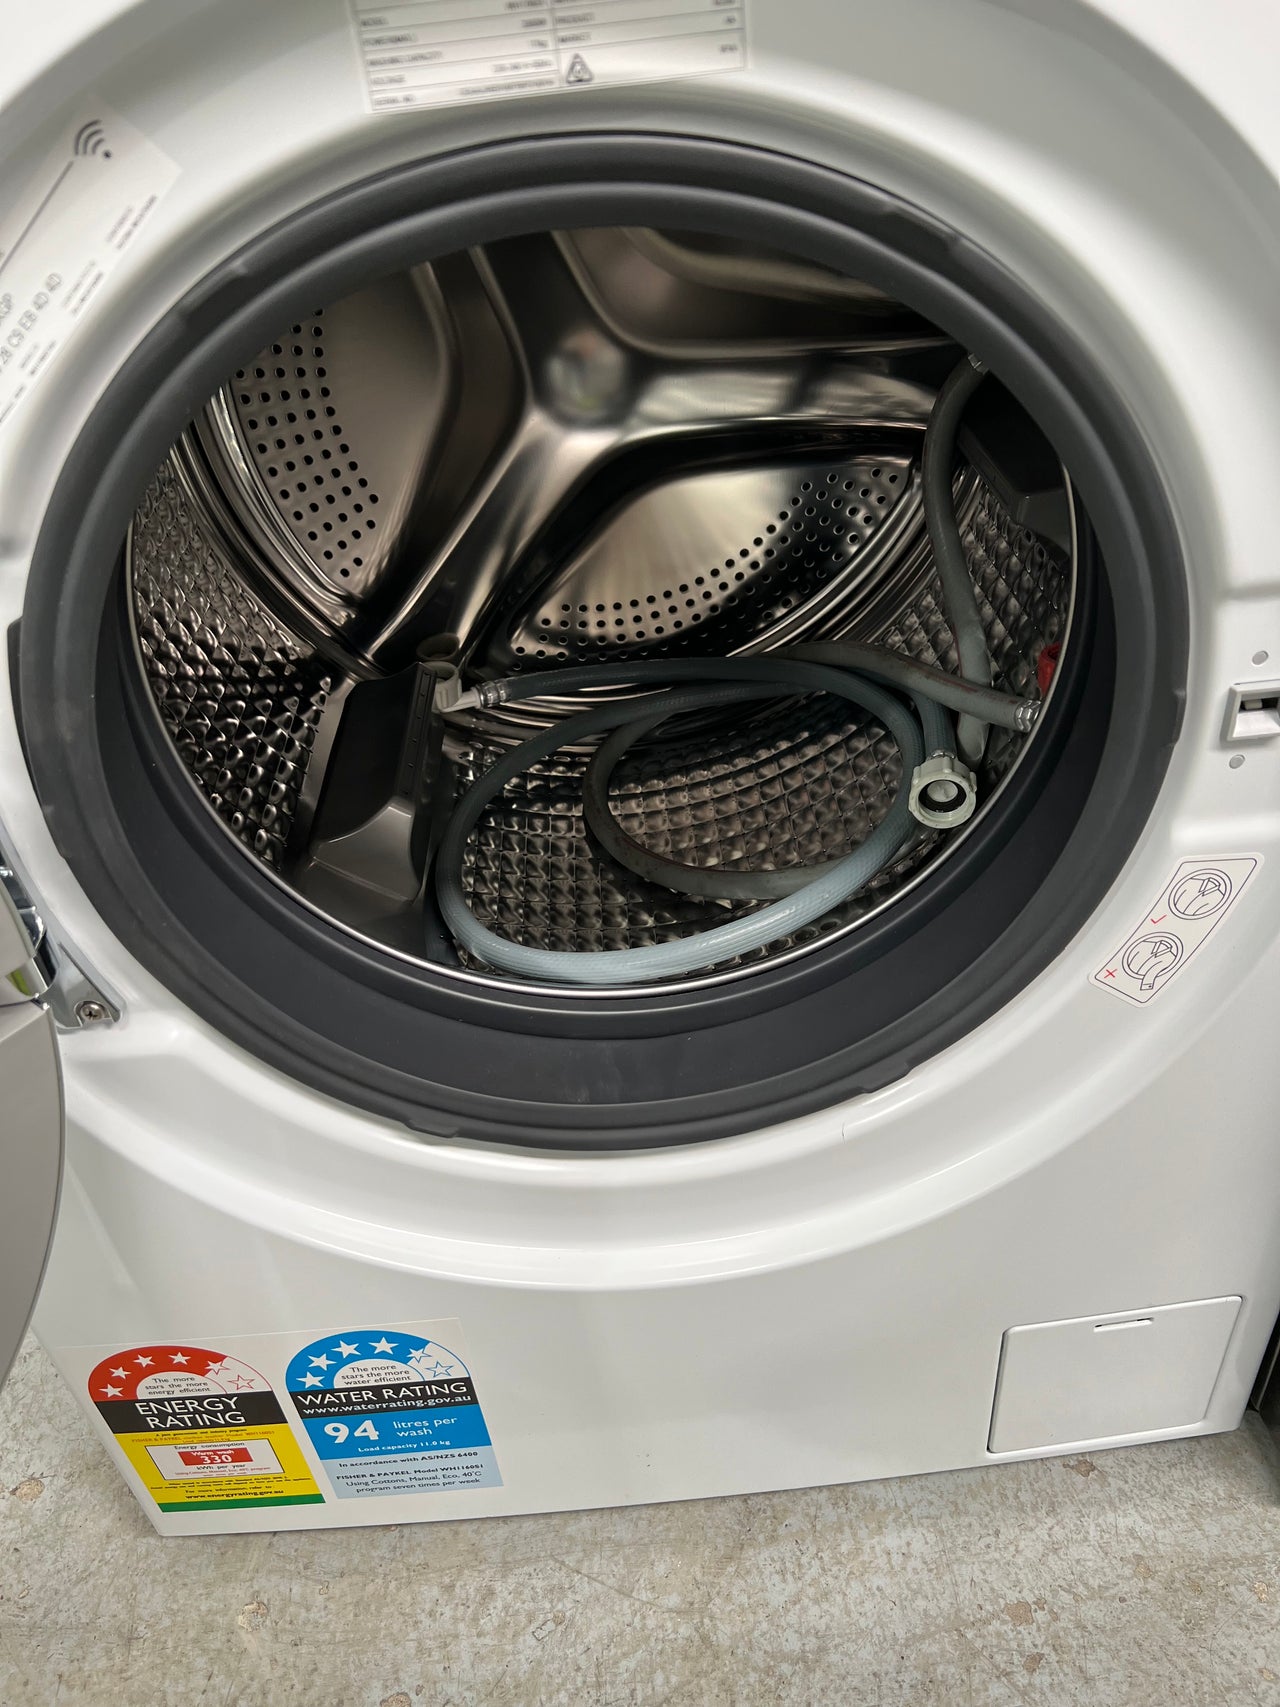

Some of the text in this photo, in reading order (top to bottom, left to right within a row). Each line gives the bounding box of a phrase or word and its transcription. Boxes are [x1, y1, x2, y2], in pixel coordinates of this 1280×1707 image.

[385, 1369, 410, 1377] more
[374, 1376, 411, 1384] efficient
[297, 1382, 467, 1406] WATER RATING
[135, 1397, 238, 1415] ENERGY
[303, 1395, 472, 1415] www.waterrating.gov.au
[146, 1411, 246, 1429] RATING
[393, 1417, 458, 1429] litres per
[323, 1419, 380, 1444] 94
[397, 1427, 433, 1437] wash
[382, 1442, 418, 1451] capacity
[200, 1454, 233, 1465] 330
[350, 1459, 398, 1467] accordance
[421, 1453, 456, 1461] AS/NZS
[379, 1470, 411, 1478] PAYKEL
[346, 1480, 369, 1488] Using
[356, 1485, 391, 1494] program
[442, 1479, 457, 1487] per
[458, 1476, 481, 1484] week
